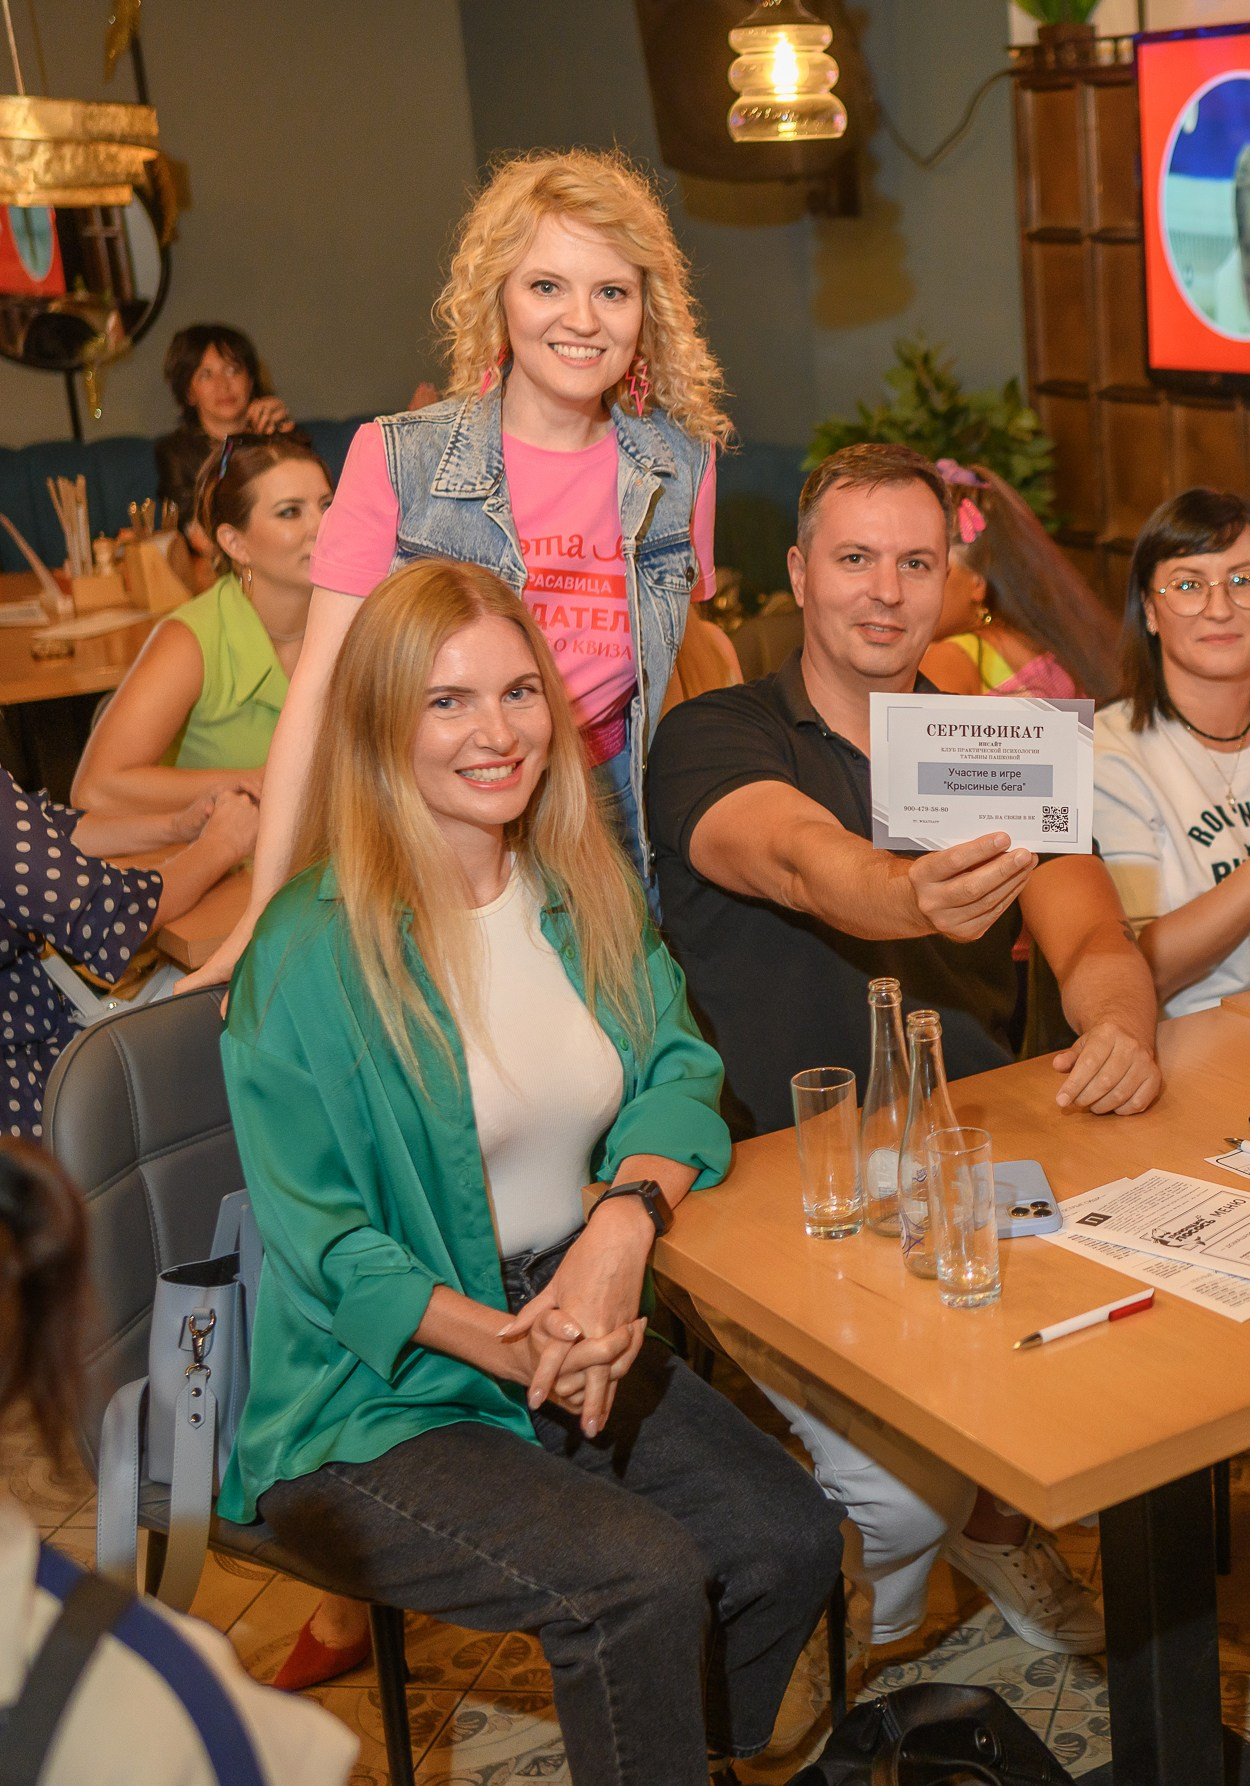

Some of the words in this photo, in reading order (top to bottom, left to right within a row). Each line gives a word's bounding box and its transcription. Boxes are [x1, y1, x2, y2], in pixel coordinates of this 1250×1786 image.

[528, 572, 613, 594] РАСАВИЦА
[926, 723, 1045, 739] СЕРТИФИКАТ
[948, 767, 989, 779] Участие
[991, 770, 997, 778] в
[999, 770, 1022, 781] игре
[943, 781, 999, 792] "Крысиные
[1001, 782, 1026, 792] бега"
[1209, 1198, 1247, 1218] МЕНЮ
